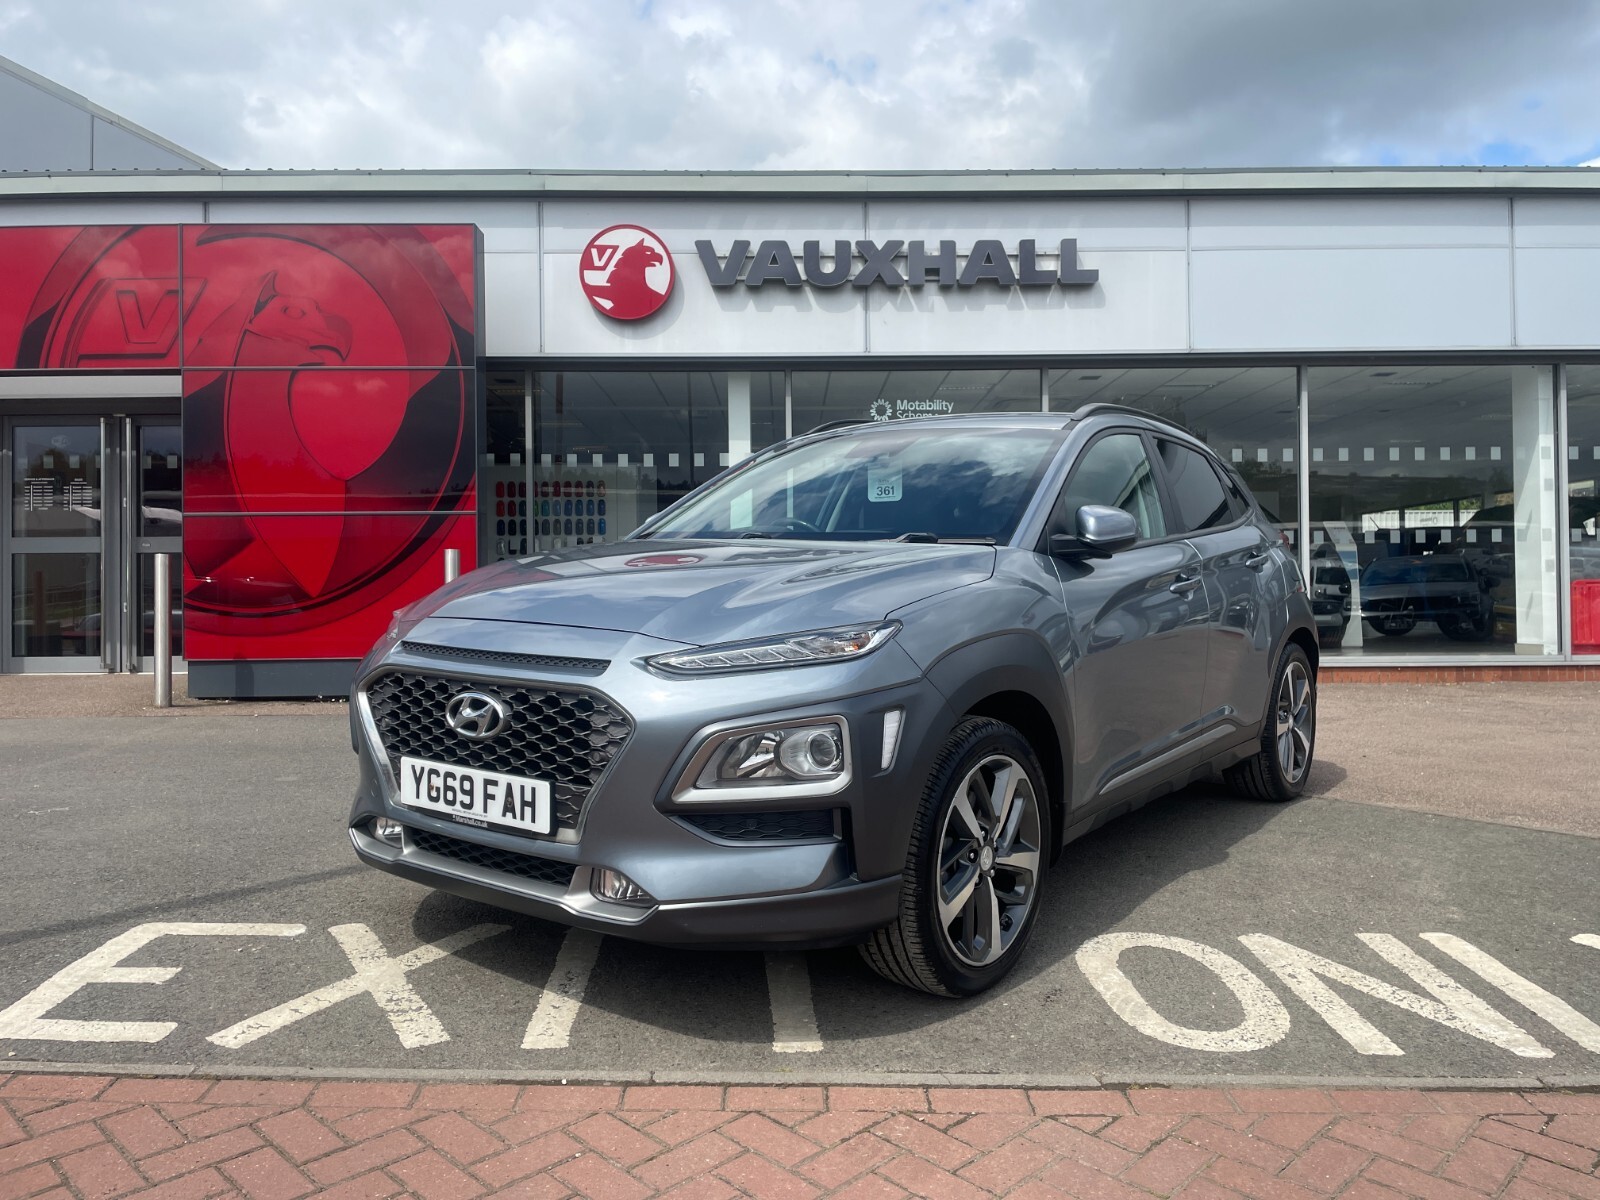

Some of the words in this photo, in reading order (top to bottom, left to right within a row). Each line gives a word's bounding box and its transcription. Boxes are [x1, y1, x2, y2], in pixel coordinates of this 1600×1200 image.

[695, 238, 1099, 288] VAUXHALL
[896, 399, 954, 413] Motability
[896, 410, 939, 419] Schem
[876, 485, 895, 497] 361
[411, 764, 474, 810] YG69
[483, 778, 536, 824] FAH
[1075, 931, 1600, 1058] ONL
